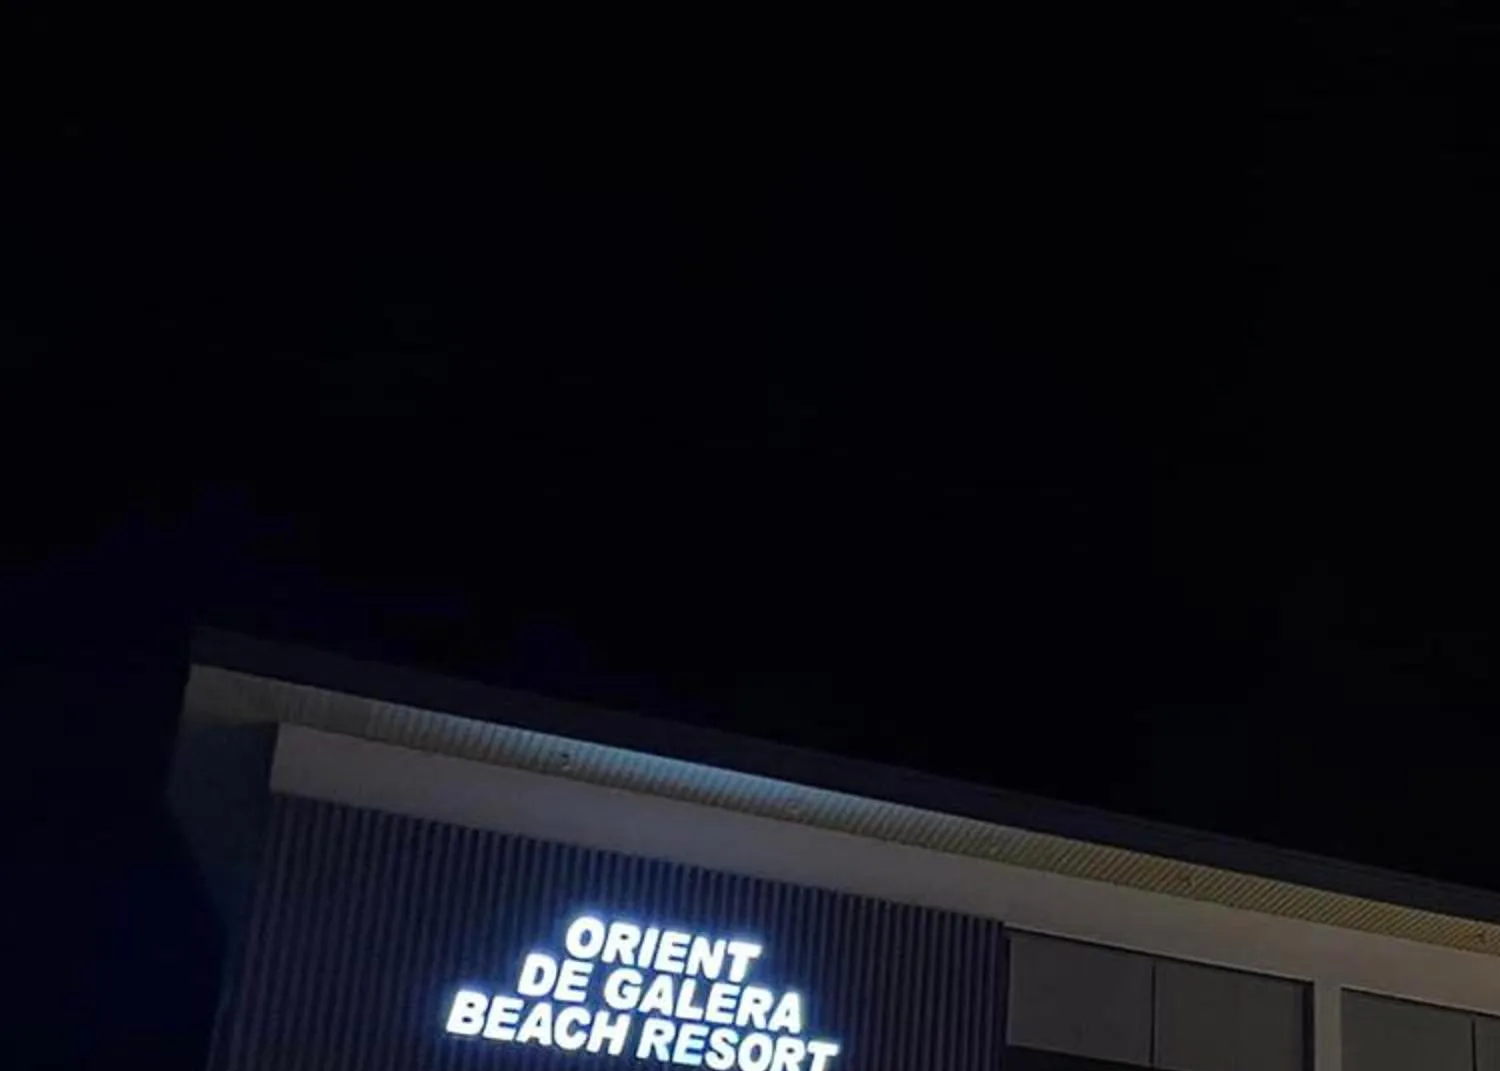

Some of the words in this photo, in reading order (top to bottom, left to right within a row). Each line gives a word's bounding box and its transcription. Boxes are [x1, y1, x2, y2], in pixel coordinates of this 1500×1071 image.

[565, 916, 762, 982] ORIENT
[445, 990, 631, 1055] BEACH
[517, 953, 593, 1002] DE
[604, 968, 802, 1033] GALERA
